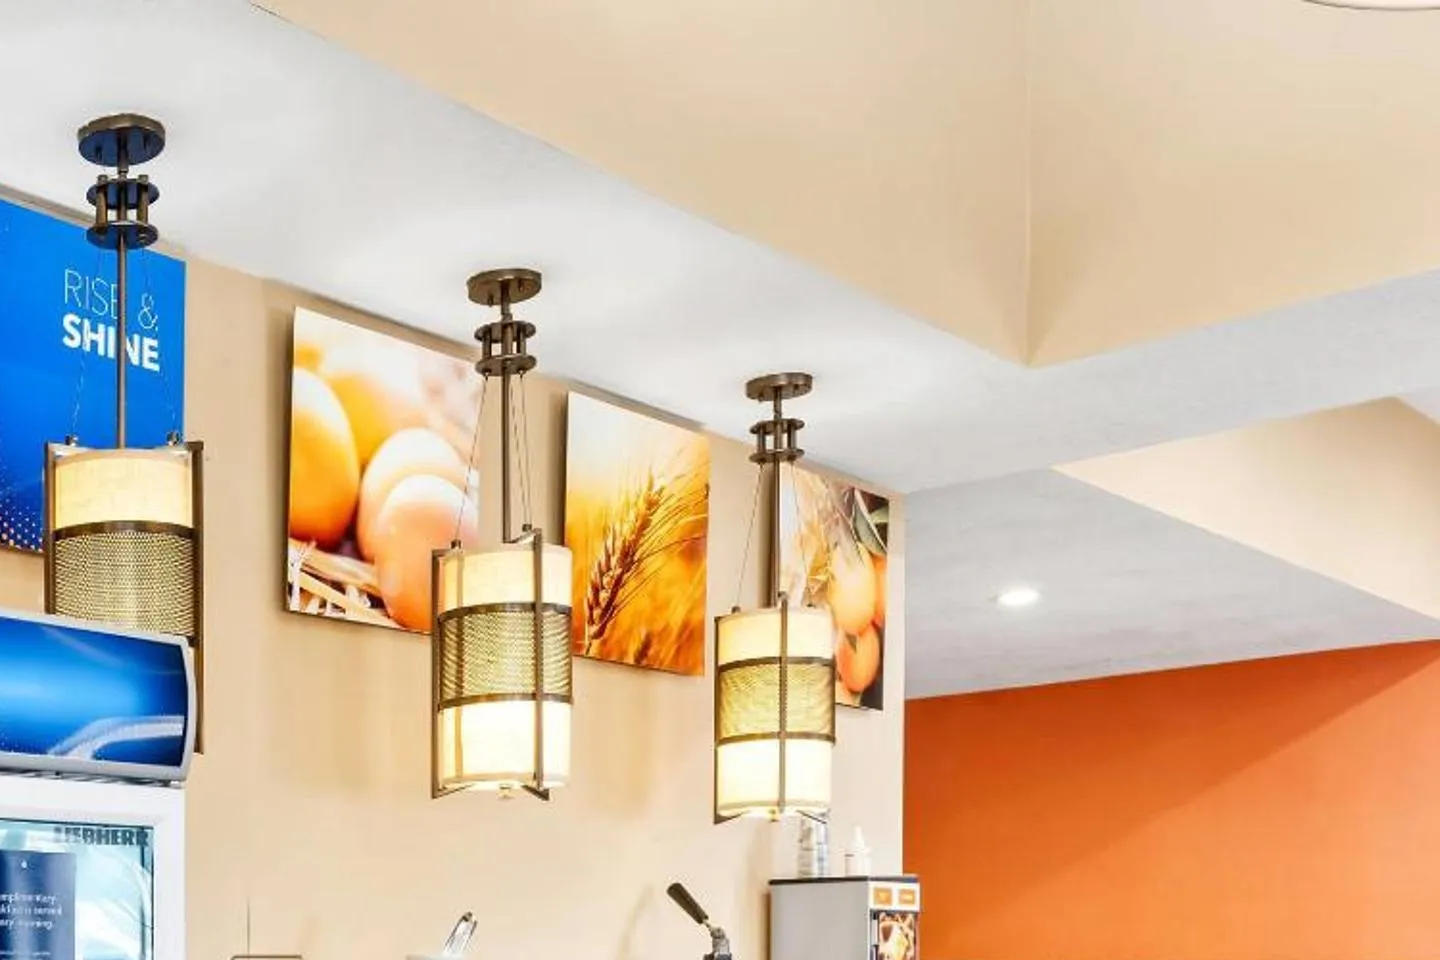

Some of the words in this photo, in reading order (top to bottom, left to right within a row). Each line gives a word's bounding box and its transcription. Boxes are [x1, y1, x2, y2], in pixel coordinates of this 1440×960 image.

[64, 268, 118, 320] RISE
[138, 292, 159, 332] &
[62, 312, 161, 372] SHINE
